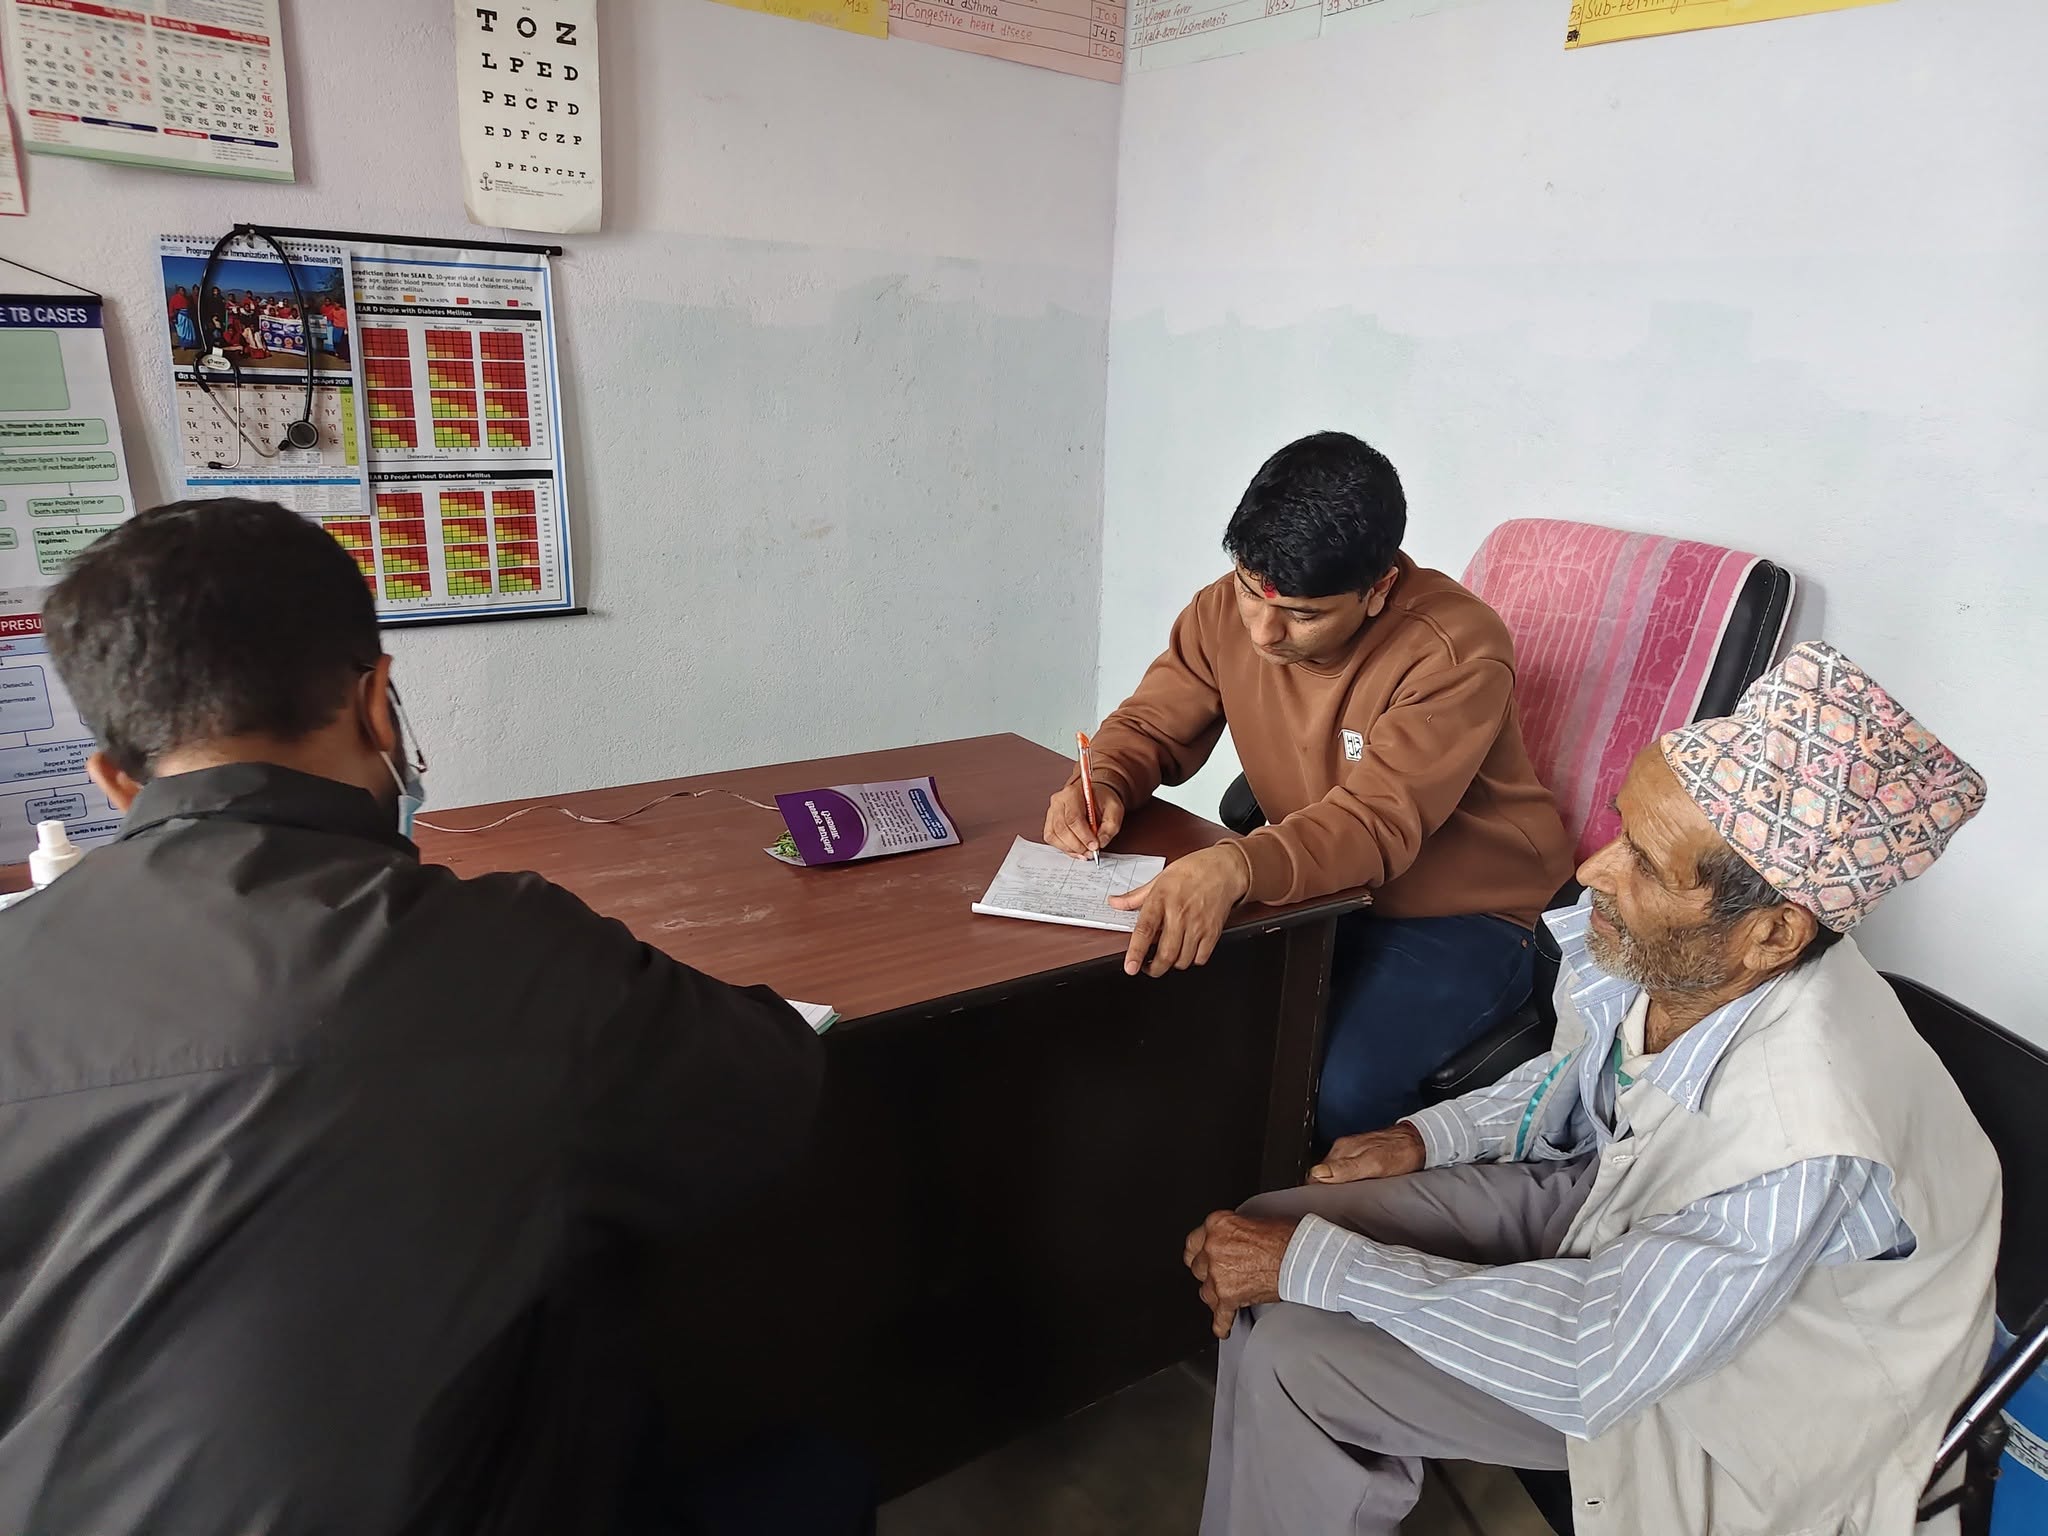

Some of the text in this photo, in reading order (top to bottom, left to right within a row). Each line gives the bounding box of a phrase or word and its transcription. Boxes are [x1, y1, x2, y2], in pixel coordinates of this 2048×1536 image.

[961, 0, 998, 16] asthma
[905, 2, 963, 27] Congestive
[970, 16, 996, 33] heart
[476, 8, 576, 46] T O Z
[1092, 24, 1117, 42] J45
[482, 52, 578, 80] L P E D
[482, 90, 580, 116] P E C F D
[484, 126, 582, 146] E D F C Z P
[230, 250, 268, 259] Immunization
[304, 255, 328, 263] Diseases
[329, 256, 343, 265] (IPD)
[8, 307, 88, 323] TB CASES
[1, 619, 42, 631] PRESU
[49, 798, 76, 806] detected
